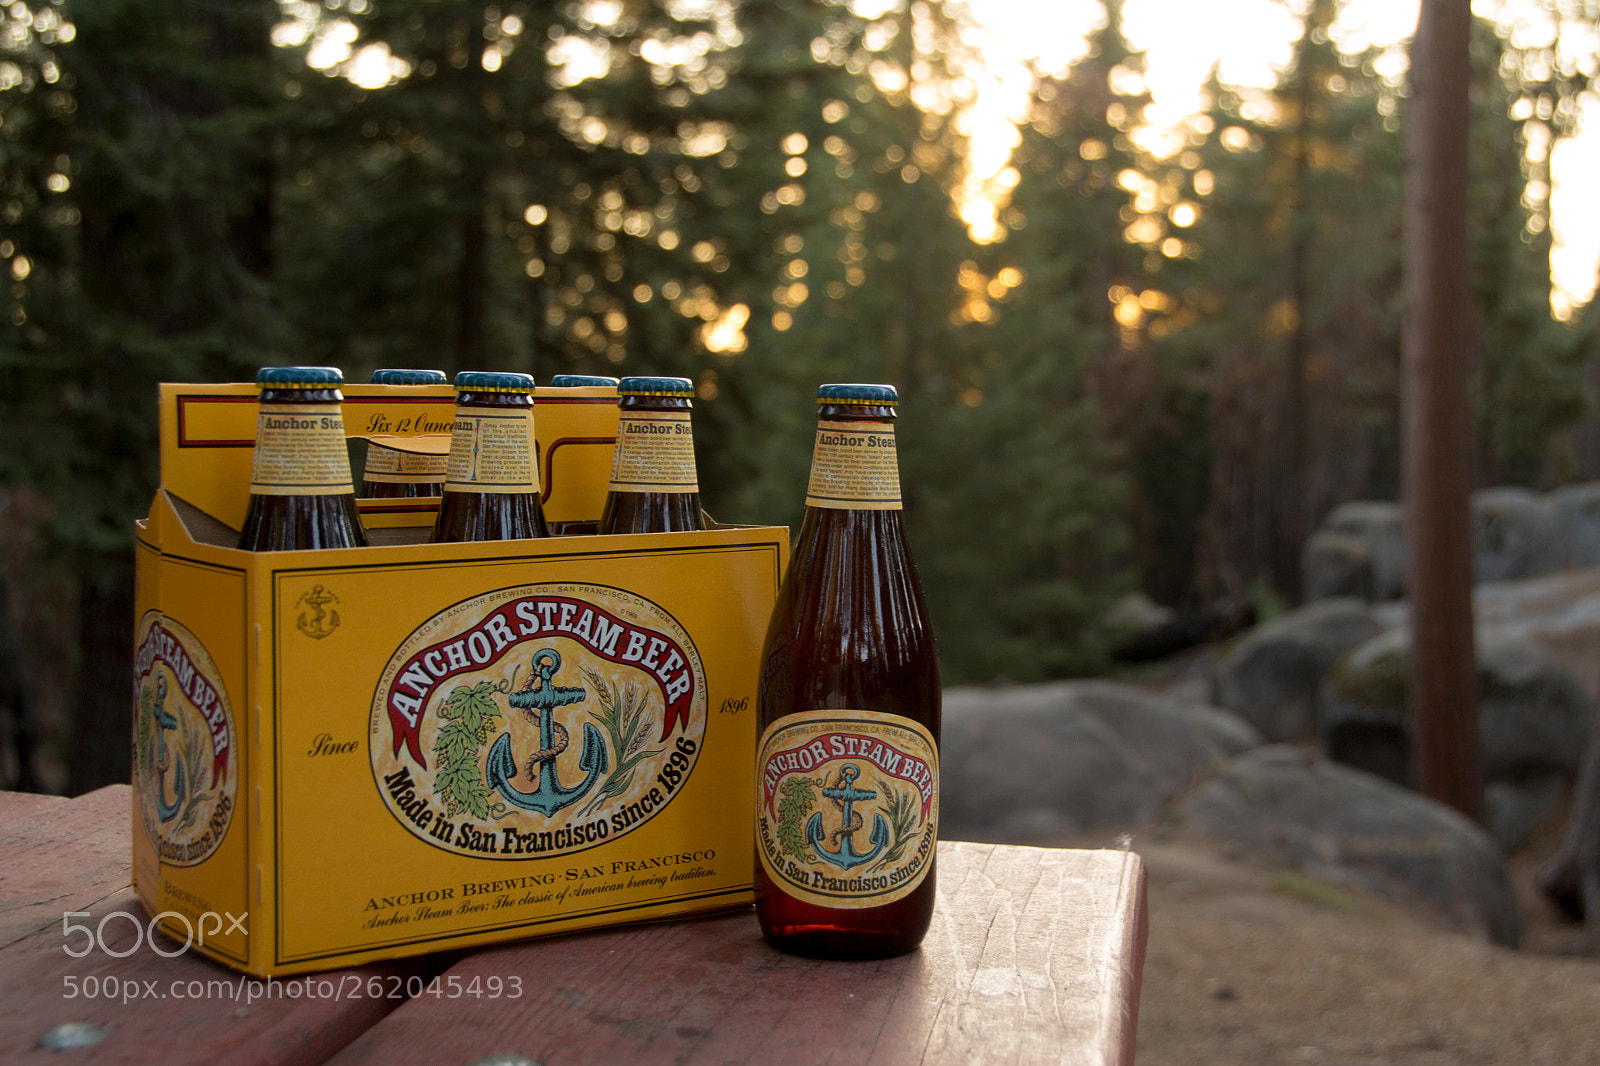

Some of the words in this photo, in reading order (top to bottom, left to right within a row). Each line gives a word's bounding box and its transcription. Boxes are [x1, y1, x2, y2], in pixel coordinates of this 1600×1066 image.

[265, 417, 317, 429] Anchor
[366, 412, 392, 433] Six
[394, 418, 412, 433] 12
[626, 422, 673, 434] Anchor
[819, 433, 864, 446] Anchor
[384, 663, 397, 683] AND
[395, 625, 432, 661] BOTTLED
[433, 615, 445, 626] BY
[447, 598, 486, 618] ANCHOR
[489, 587, 533, 602] BREWING
[557, 585, 575, 593] SAN
[649, 606, 671, 624] FROM
[671, 624, 684, 640] ALL
[683, 639, 702, 673] BARLEY
[392, 613, 517, 728] ANCHOR
[515, 601, 625, 657] STEAM
[621, 630, 691, 704] BEER
[193, 674, 229, 756] BEER
[719, 696, 749, 714] 1896
[307, 732, 359, 757] Since
[765, 740, 829, 797] ANCHOR
[829, 735, 902, 775] STEAM
[901, 757, 933, 804] BEER
[209, 790, 232, 842] 1896
[384, 766, 433, 830] Made
[429, 812, 455, 843] in
[455, 822, 496, 853] San
[500, 819, 608, 854] Francisco
[611, 787, 665, 834] since
[657, 736, 696, 795] 1896
[364, 887, 454, 911] ANCHOR
[461, 872, 555, 897] BREWING
[565, 865, 611, 881] SAN
[611, 849, 716, 875] FRANCISCO
[760, 816, 777, 855] Made
[774, 852, 785, 871] in
[785, 861, 810, 885] San
[811, 871, 888, 892] Francisco
[890, 856, 921, 885] since
[918, 822, 934, 860] 1896
[361, 912, 411, 930] Anchor
[412, 905, 453, 922] Steam
[456, 900, 489, 915] Beer:
[491, 894, 516, 910] The
[518, 889, 554, 906] classic
[555, 886, 570, 901] of
[568, 881, 624, 898] American
[626, 872, 667, 890] brewing
[669, 865, 717, 883] tradition.
